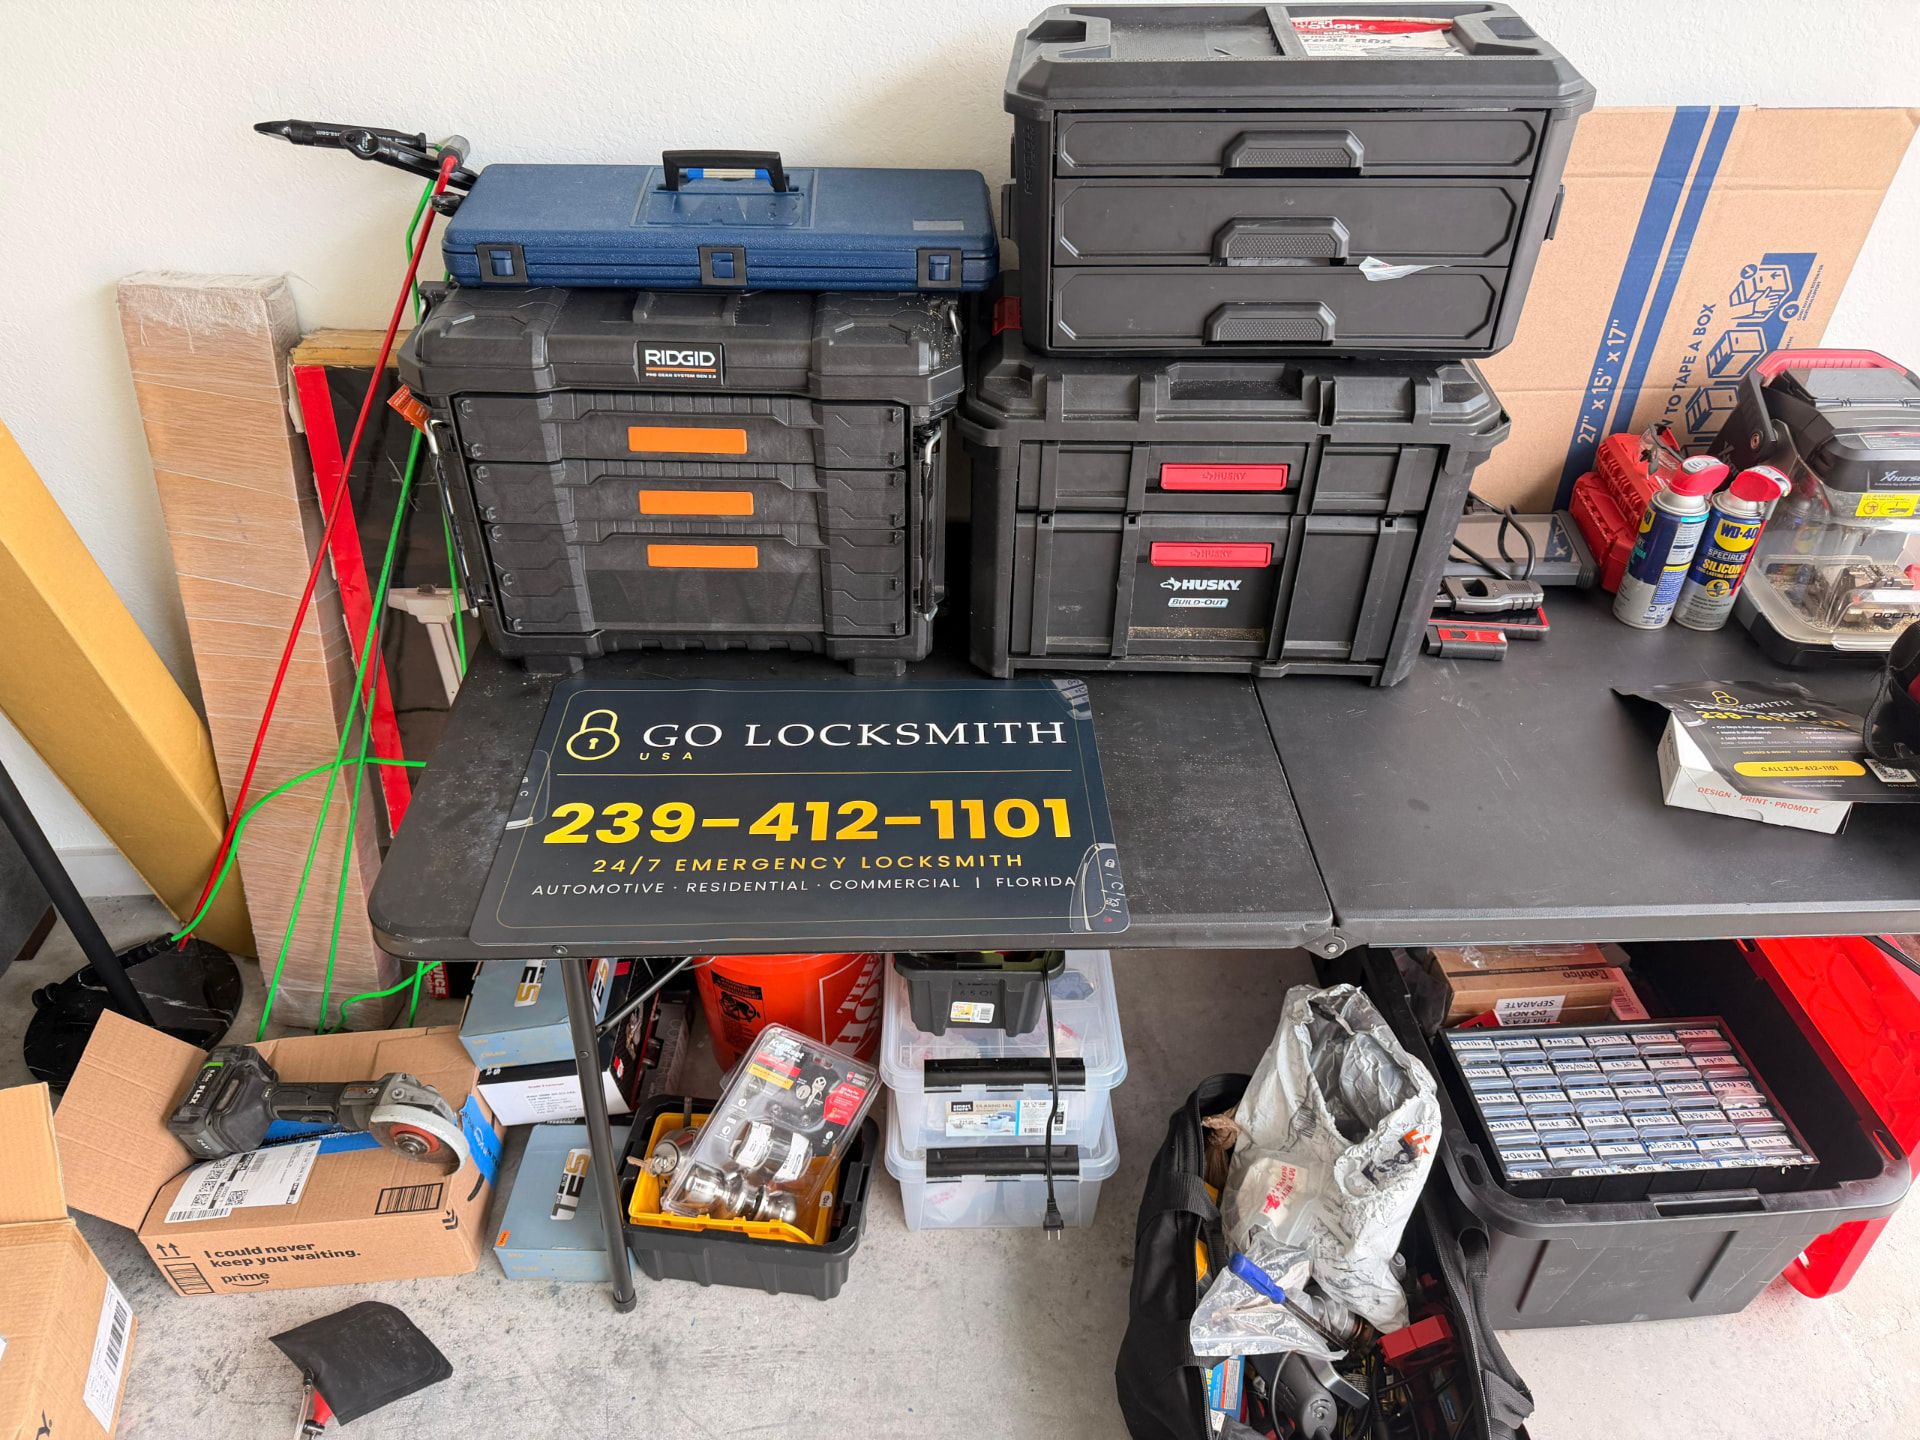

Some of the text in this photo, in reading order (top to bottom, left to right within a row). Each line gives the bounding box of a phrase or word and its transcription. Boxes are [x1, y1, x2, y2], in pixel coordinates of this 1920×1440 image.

[1692, 303, 1717, 336] BOX
[1688, 340, 1702, 352] A
[645, 349, 716, 367] RIDGID
[1672, 355, 1698, 389] TAPE
[1664, 394, 1682, 415] TO
[1213, 471, 1247, 481] HUSKY
[1203, 549, 1233, 558] HUSKY
[1707, 549, 1748, 562] SPECIALIS
[1703, 558, 1745, 575] SILICON
[1181, 579, 1243, 591] HUSKY
[642, 721, 1067, 748] GO LOCKSMITH
[1760, 765, 1784, 773] CALL
[1697, 787, 1821, 815] DESIGN PRINT PROMOTE
[543, 798, 1072, 844] 239-412-1101
[591, 854, 1023, 875] 24/7 EMERGENCY LOCKSMITH
[531, 876, 1076, 896] AUTOMOTIVE RESIDENTIAL COMMERCIAL FLORIDA
[1504, 998, 1556, 1009] SEPARATE
[1506, 1009, 1548, 1018] DO NOT
[189, 1085, 206, 1105] FLEX
[203, 1243, 315, 1259] I could never
[210, 1250, 362, 1268] keep you waiting.
[221, 1272, 271, 1285] prime
